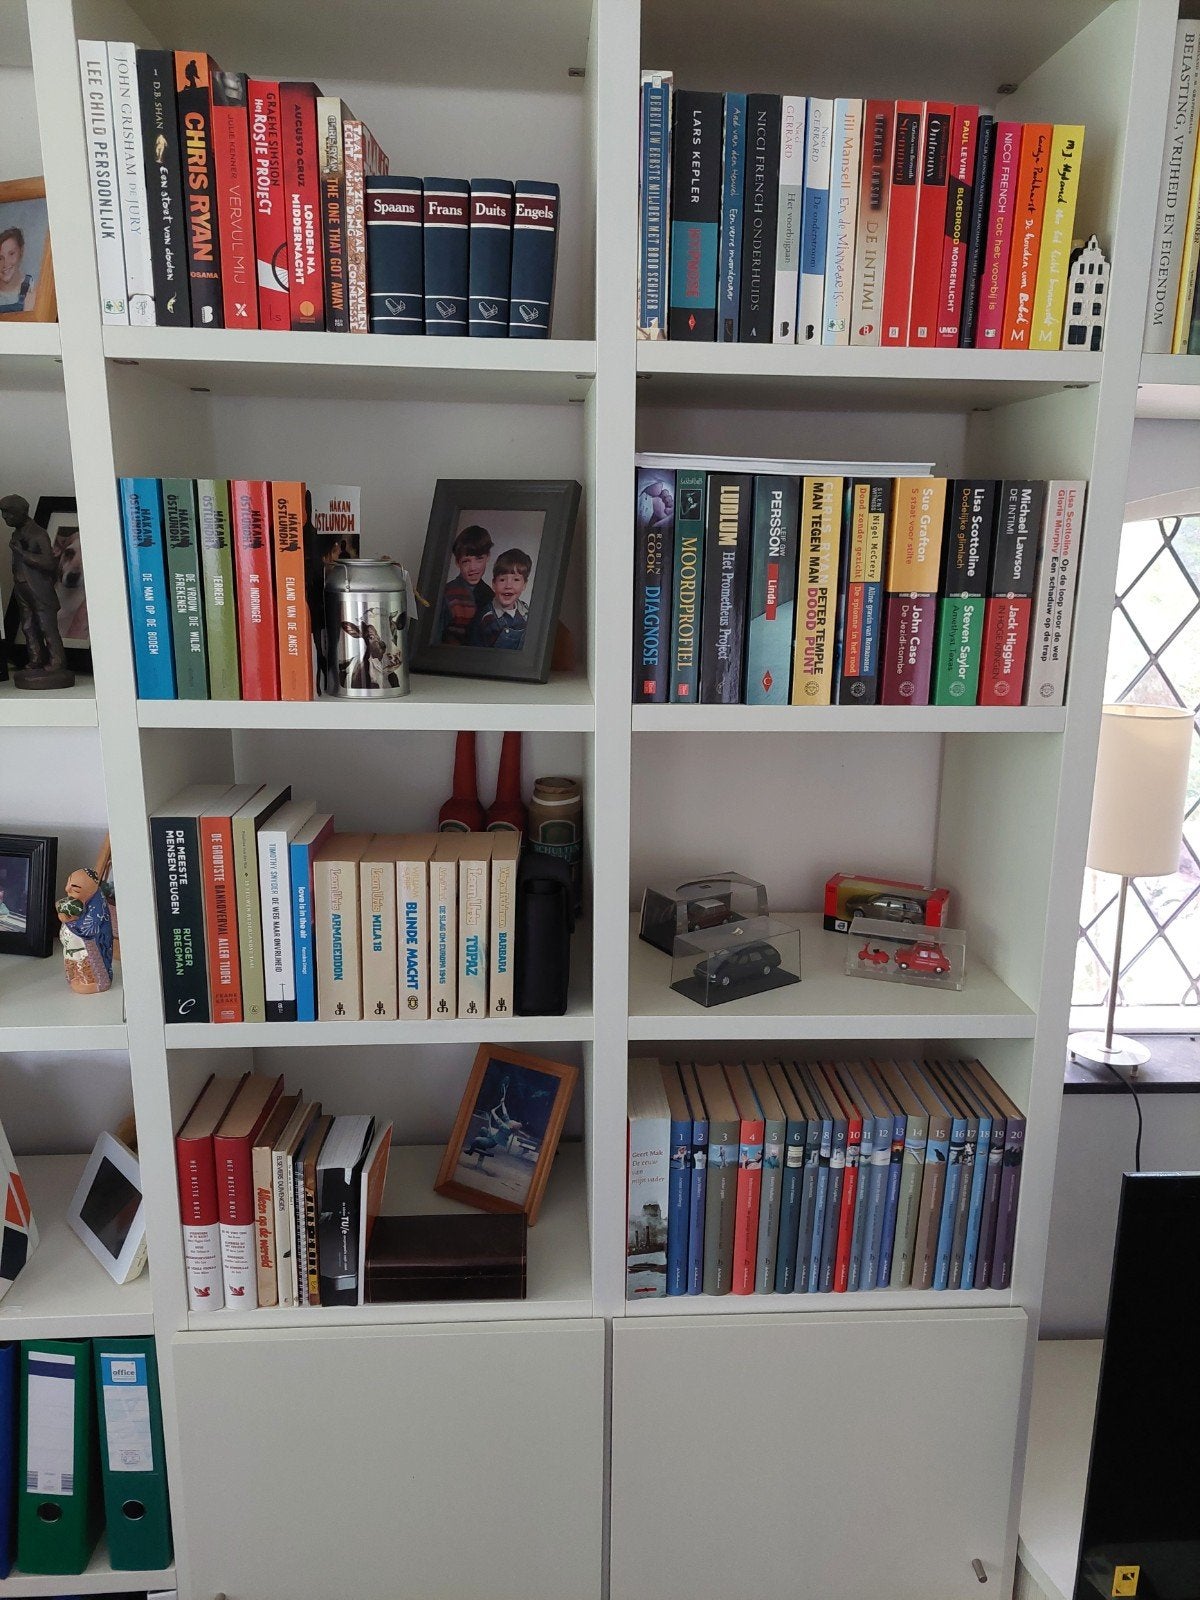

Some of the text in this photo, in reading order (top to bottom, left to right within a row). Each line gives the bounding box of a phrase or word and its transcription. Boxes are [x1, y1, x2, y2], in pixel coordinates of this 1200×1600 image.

[1174, 33, 1195, 130] BELASTING,
[87, 61, 115, 239] LEE CHILD PERSOONLIJK
[113, 57, 141, 234] JOHN GRISHAM DE JURY
[229, 141, 237, 179] KENNER
[266, 92, 280, 187] GRAEME SIMSION
[294, 104, 305, 187] AUGUSTO CRUZ
[691, 110, 702, 203] LARS KEPLER
[840, 112, 856, 189] Jill Mansell
[1002, 132, 1013, 163] NICCI
[184, 112, 213, 261] CHRIS RYAN
[326, 178, 339, 199] THE
[997, 166, 1010, 213] FRENCH
[1166, 135, 1184, 209] VRIJHEID
[229, 185, 243, 251] VERVUL
[327, 203, 339, 224] ONE
[374, 199, 415, 214] Spaans
[428, 201, 463, 216] Frans
[475, 202, 507, 217] Duits
[515, 203, 554, 220] Engels
[751, 111, 767, 311] NICCI FRENCH ONDERHUIDS
[946, 120, 971, 312] PAUL LEVINE BLOEDROOD MORGENLICHT
[1163, 214, 1175, 235] EN
[291, 193, 304, 284] MIDDERNACHT
[304, 204, 315, 275] LONDEN NA
[329, 228, 341, 254] THAT
[993, 239, 1003, 259] het
[190, 271, 219, 279] OSAMA
[233, 255, 245, 284] MIJ
[330, 257, 342, 278] GOT
[686, 228, 702, 298] HYPNOSE
[861, 221, 879, 311] DE INTIMI
[988, 262, 999, 299] voorbij
[1152, 240, 1172, 326] EIGENDOM
[331, 282, 344, 310] AWAY
[988, 302, 997, 311] is
[329, 496, 351, 513] HÅKAN
[769, 491, 783, 557] PERSSON
[910, 497, 918, 518] staat
[917, 488, 933, 562] Sue Grafton
[1006, 488, 1018, 535] DE INTIMI
[808, 482, 824, 584] MAN TEGEN MAN
[867, 515, 880, 579] Nigel McCrery
[907, 521, 915, 541] voor
[967, 488, 985, 577] Lisa Scottoline
[1012, 488, 1032, 580] Michael Lawson
[646, 533, 656, 574] COOK
[715, 486, 740, 660] LUDLUM Het Prometheus Project
[906, 543, 914, 565] stilte
[175, 572, 187, 614] AFREKENEN
[213, 575, 225, 606] TERREUR
[677, 537, 698, 671] MOORDPROFIEL
[766, 580, 777, 605] Linda
[142, 573, 159, 655] DE MAN OP DE BODEM
[185, 573, 201, 653] DE VROUW DIE WILDE
[285, 577, 298, 656] EILAND VAN DE ANGST
[642, 586, 661, 666] DIAGNOSE
[803, 587, 818, 675] DOOD PUNT
[813, 587, 828, 675] PETER TEMPLE
[908, 605, 923, 665] John Case
[956, 605, 974, 680] Steven Saylor
[1003, 605, 1020, 674] Jack Higgins
[165, 830, 180, 915] MENSEN DEUGEN
[176, 830, 188, 885] DE MEESTE
[211, 833, 230, 986] DE GROOTSTE BANKOVERVAL ALLER TIJDEN
[297, 886, 306, 903] love
[299, 917, 307, 929] the
[372, 914, 382, 952] MILA 18
[173, 928, 184, 976] BREGMAN
[183, 927, 194, 967] RUTGER
[331, 913, 344, 981] ARMAGEDDON
[405, 901, 419, 990] BLINDE MACHT
[466, 935, 479, 977] TOPAZ
[498, 932, 508, 974] BARBARA
[679, 1133, 683, 1141] 1
[697, 1133, 704, 1141] 2
[722, 1133, 728, 1142] 3
[850, 1131, 861, 1139] 10
[878, 1129, 889, 1138] 12
[955, 1130, 965, 1138] 16
[1010, 1131, 1023, 1139] 20
[191, 1177, 200, 1197] BESTE
[276, 1155, 284, 1180] ELSEVIERS
[193, 1202, 201, 1219] BOEK
[255, 1187, 273, 1269] Alleen op de wereld
[341, 1215, 350, 1235] TU/e
[112, 1369, 136, 1377] office
